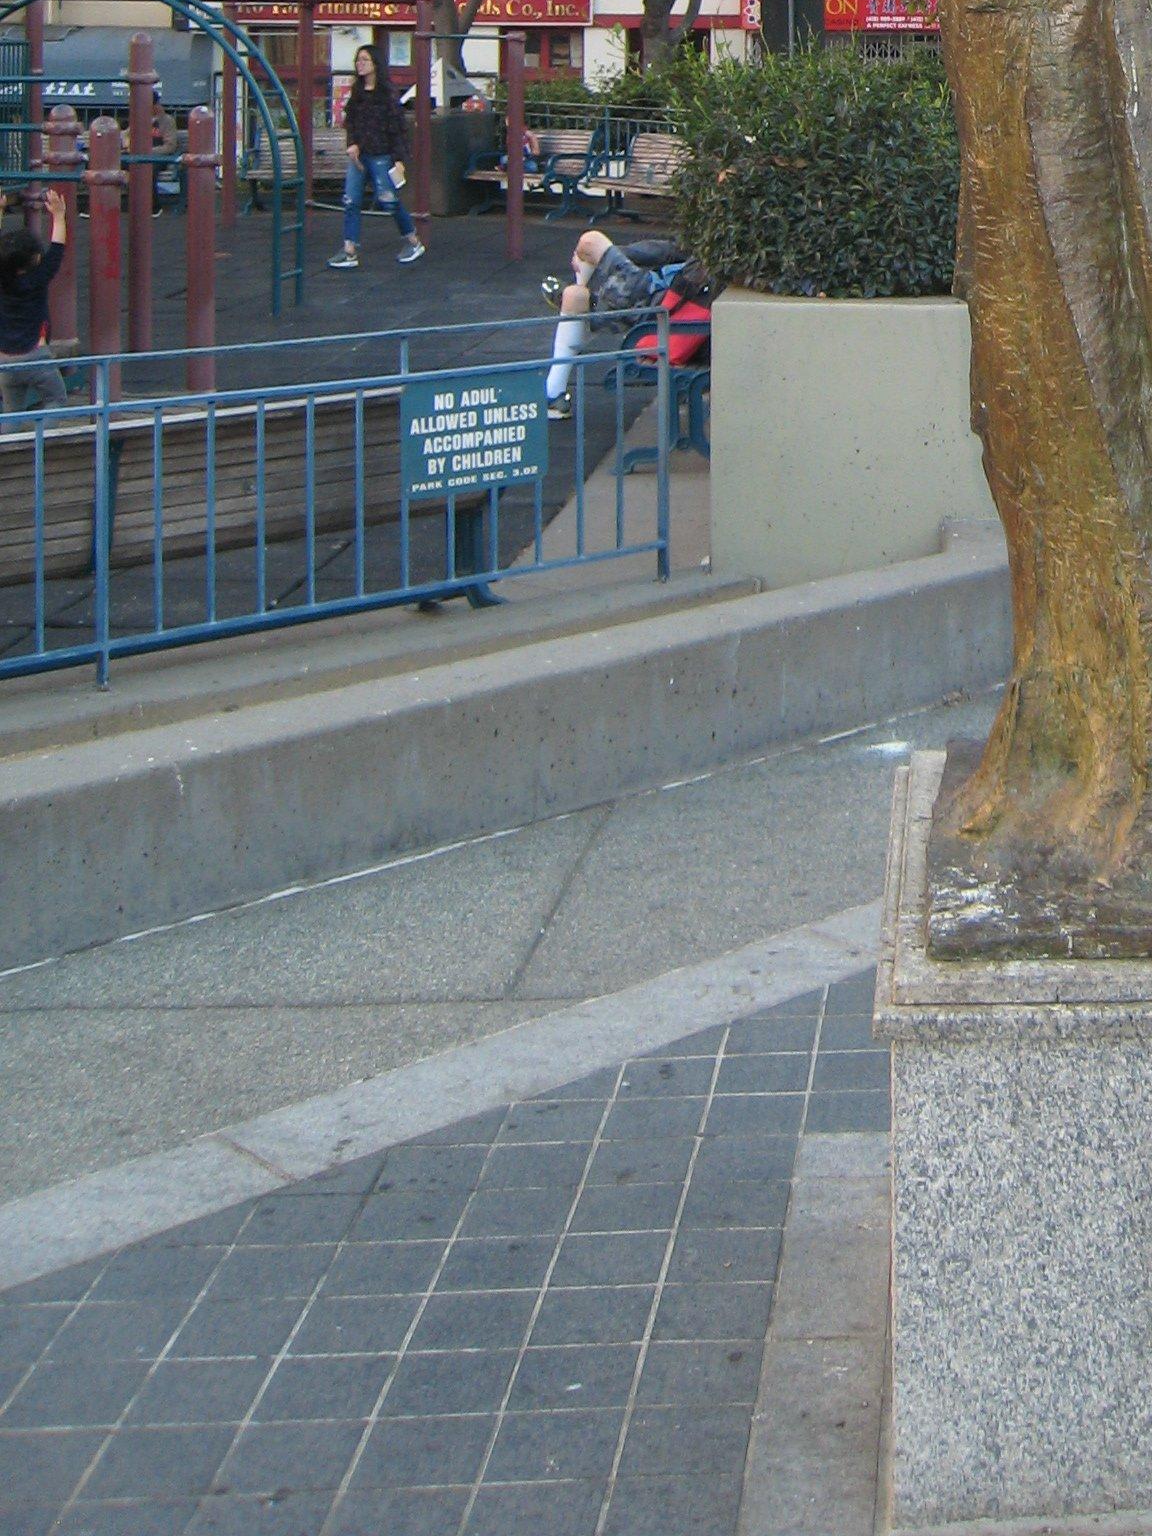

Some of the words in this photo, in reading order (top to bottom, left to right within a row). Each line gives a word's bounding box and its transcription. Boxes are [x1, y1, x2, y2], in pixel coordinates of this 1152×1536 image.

[546, 0, 581, 16] Inc.
[434, 393, 454, 411] NO
[410, 411, 477, 435] ALLOWED
[484, 403, 538, 425] UNLESS
[423, 425, 526, 455] ACCOMPANIED
[428, 457, 446, 475] BY
[452, 446, 522, 472] CHILDREN
[411, 480, 442, 493] PARK
[448, 474, 477, 487] CODE
